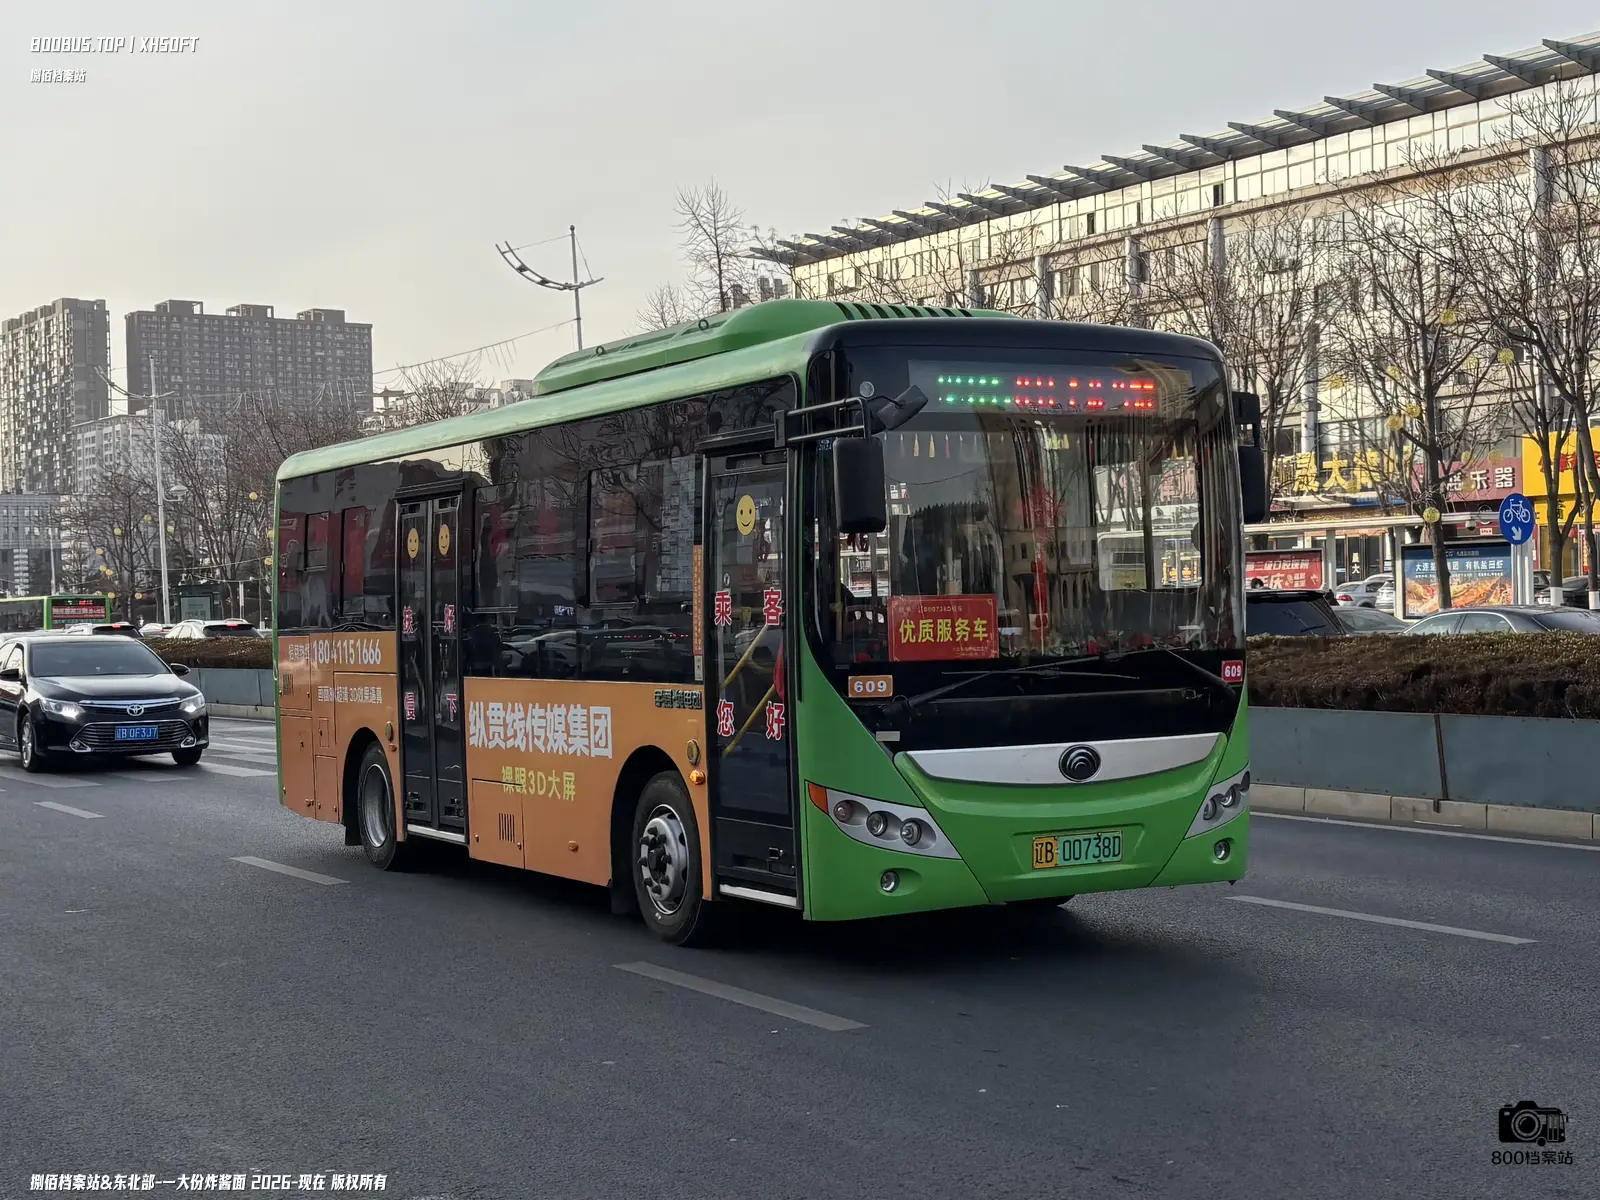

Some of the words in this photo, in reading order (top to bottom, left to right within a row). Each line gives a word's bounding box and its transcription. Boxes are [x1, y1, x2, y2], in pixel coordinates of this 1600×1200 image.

[899, 618, 988, 643] 优质服务车
[1224, 665, 1241, 677] 609
[853, 680, 887, 693] 609
[469, 701, 613, 759] 纵贯线传媒集团
[502, 766, 576, 801] 裸眼3D大屏
